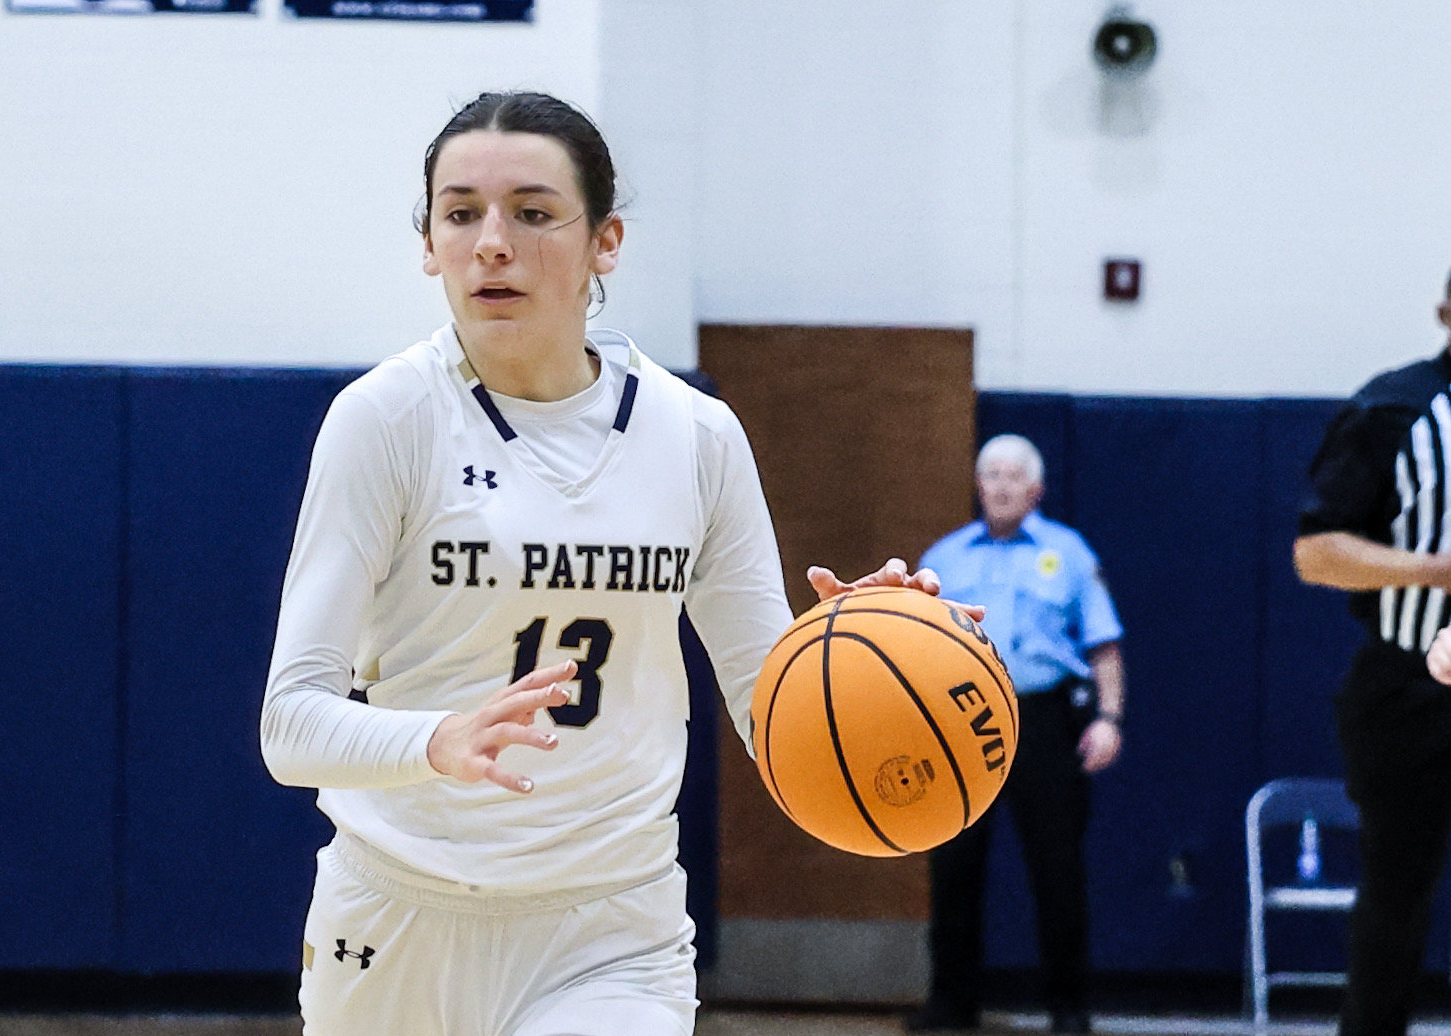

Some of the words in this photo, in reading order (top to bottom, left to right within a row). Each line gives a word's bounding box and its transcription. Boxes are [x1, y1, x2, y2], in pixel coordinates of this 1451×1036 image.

[430, 540, 498, 587] ST.
[520, 543, 690, 593] PATRICK
[509, 615, 615, 729] 13
[948, 681, 1006, 772] EVO
